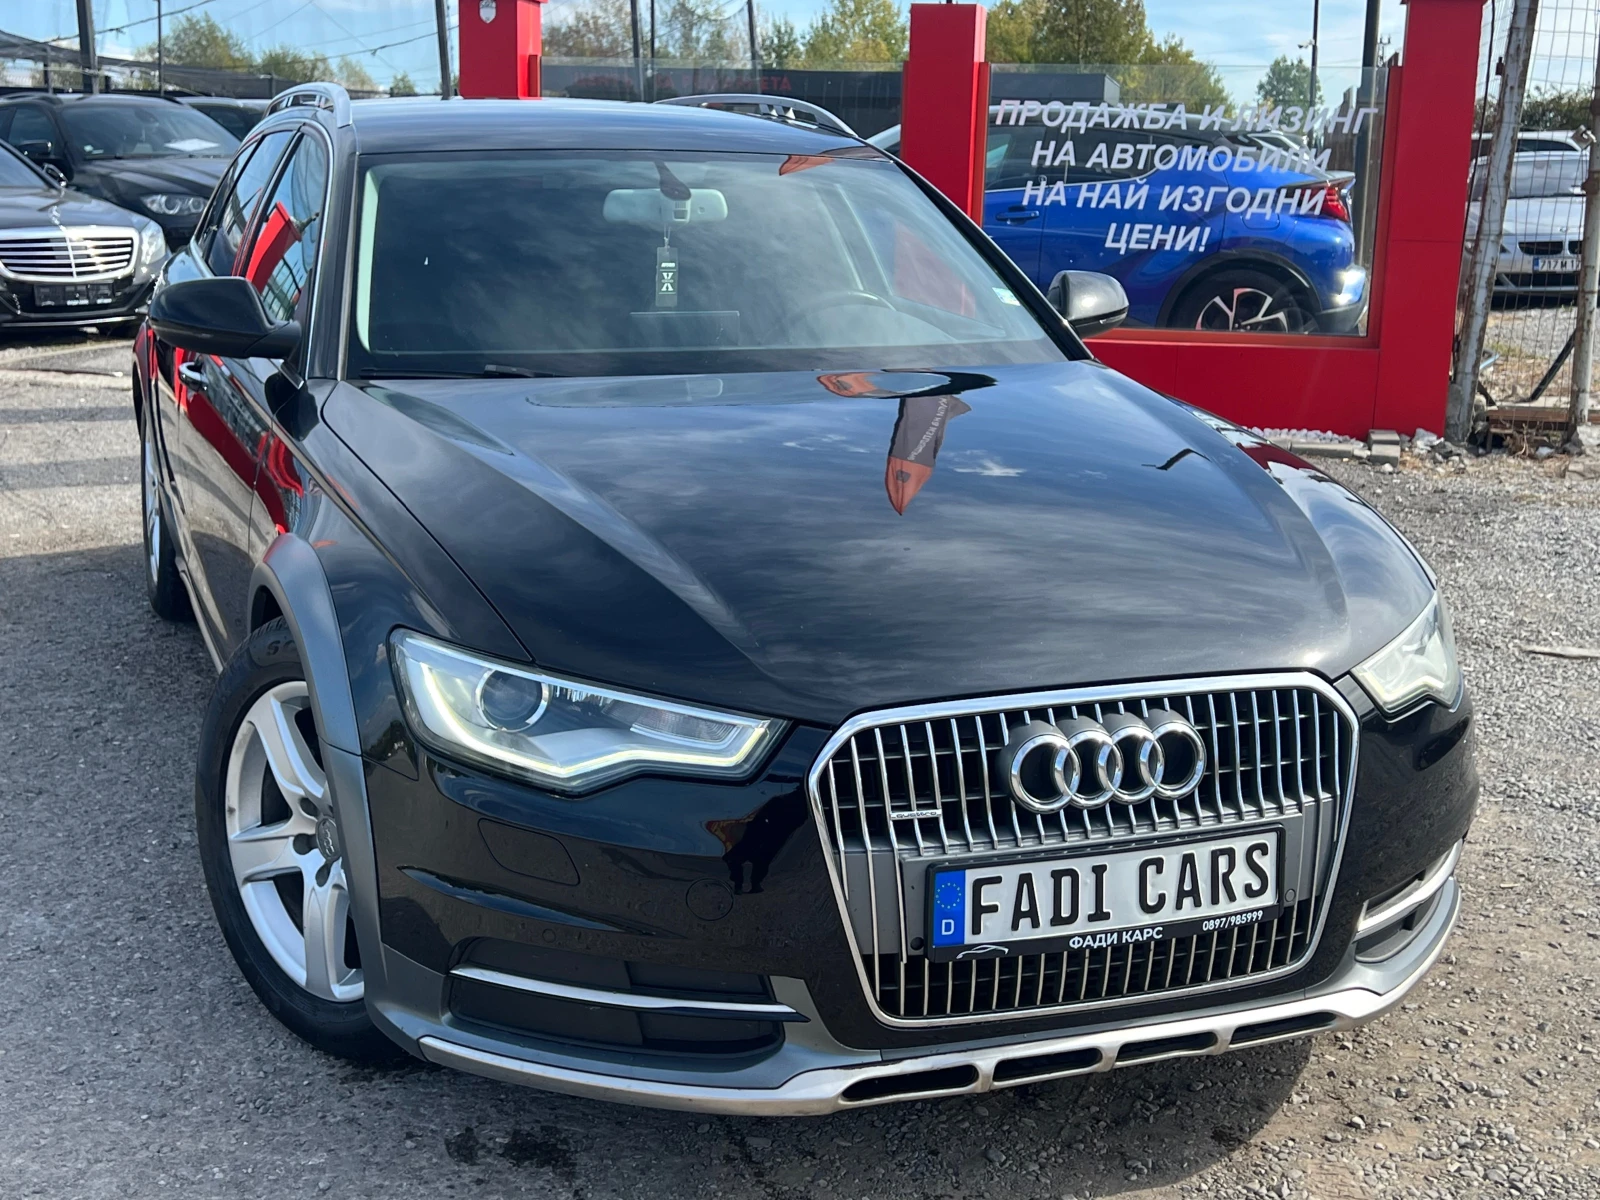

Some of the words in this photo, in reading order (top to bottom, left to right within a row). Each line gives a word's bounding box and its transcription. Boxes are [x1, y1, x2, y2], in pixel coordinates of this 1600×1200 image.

[996, 99, 1188, 134] ПРОДАЖБА
[1199, 104, 1222, 131] И
[1230, 105, 1379, 134] ЛИЗИНГ
[1031, 140, 1077, 167] НА
[1085, 143, 1332, 174] АВТОМОБИЛИ
[1022, 180, 1067, 207] НА
[1077, 178, 1151, 210] НАЙ
[1159, 184, 1327, 221] ИЗГОДНИ
[1104, 222, 1212, 255] ЦЕНИ!
[895, 811, 937, 819] quattro
[971, 863, 1111, 936] FADI
[1138, 842, 1270, 915] CARS
[941, 918, 955, 936] D
[1202, 909, 1263, 931] 0897/985999
[1068, 932, 1118, 950] ФАДИ
[1122, 927, 1164, 945] КАРС
